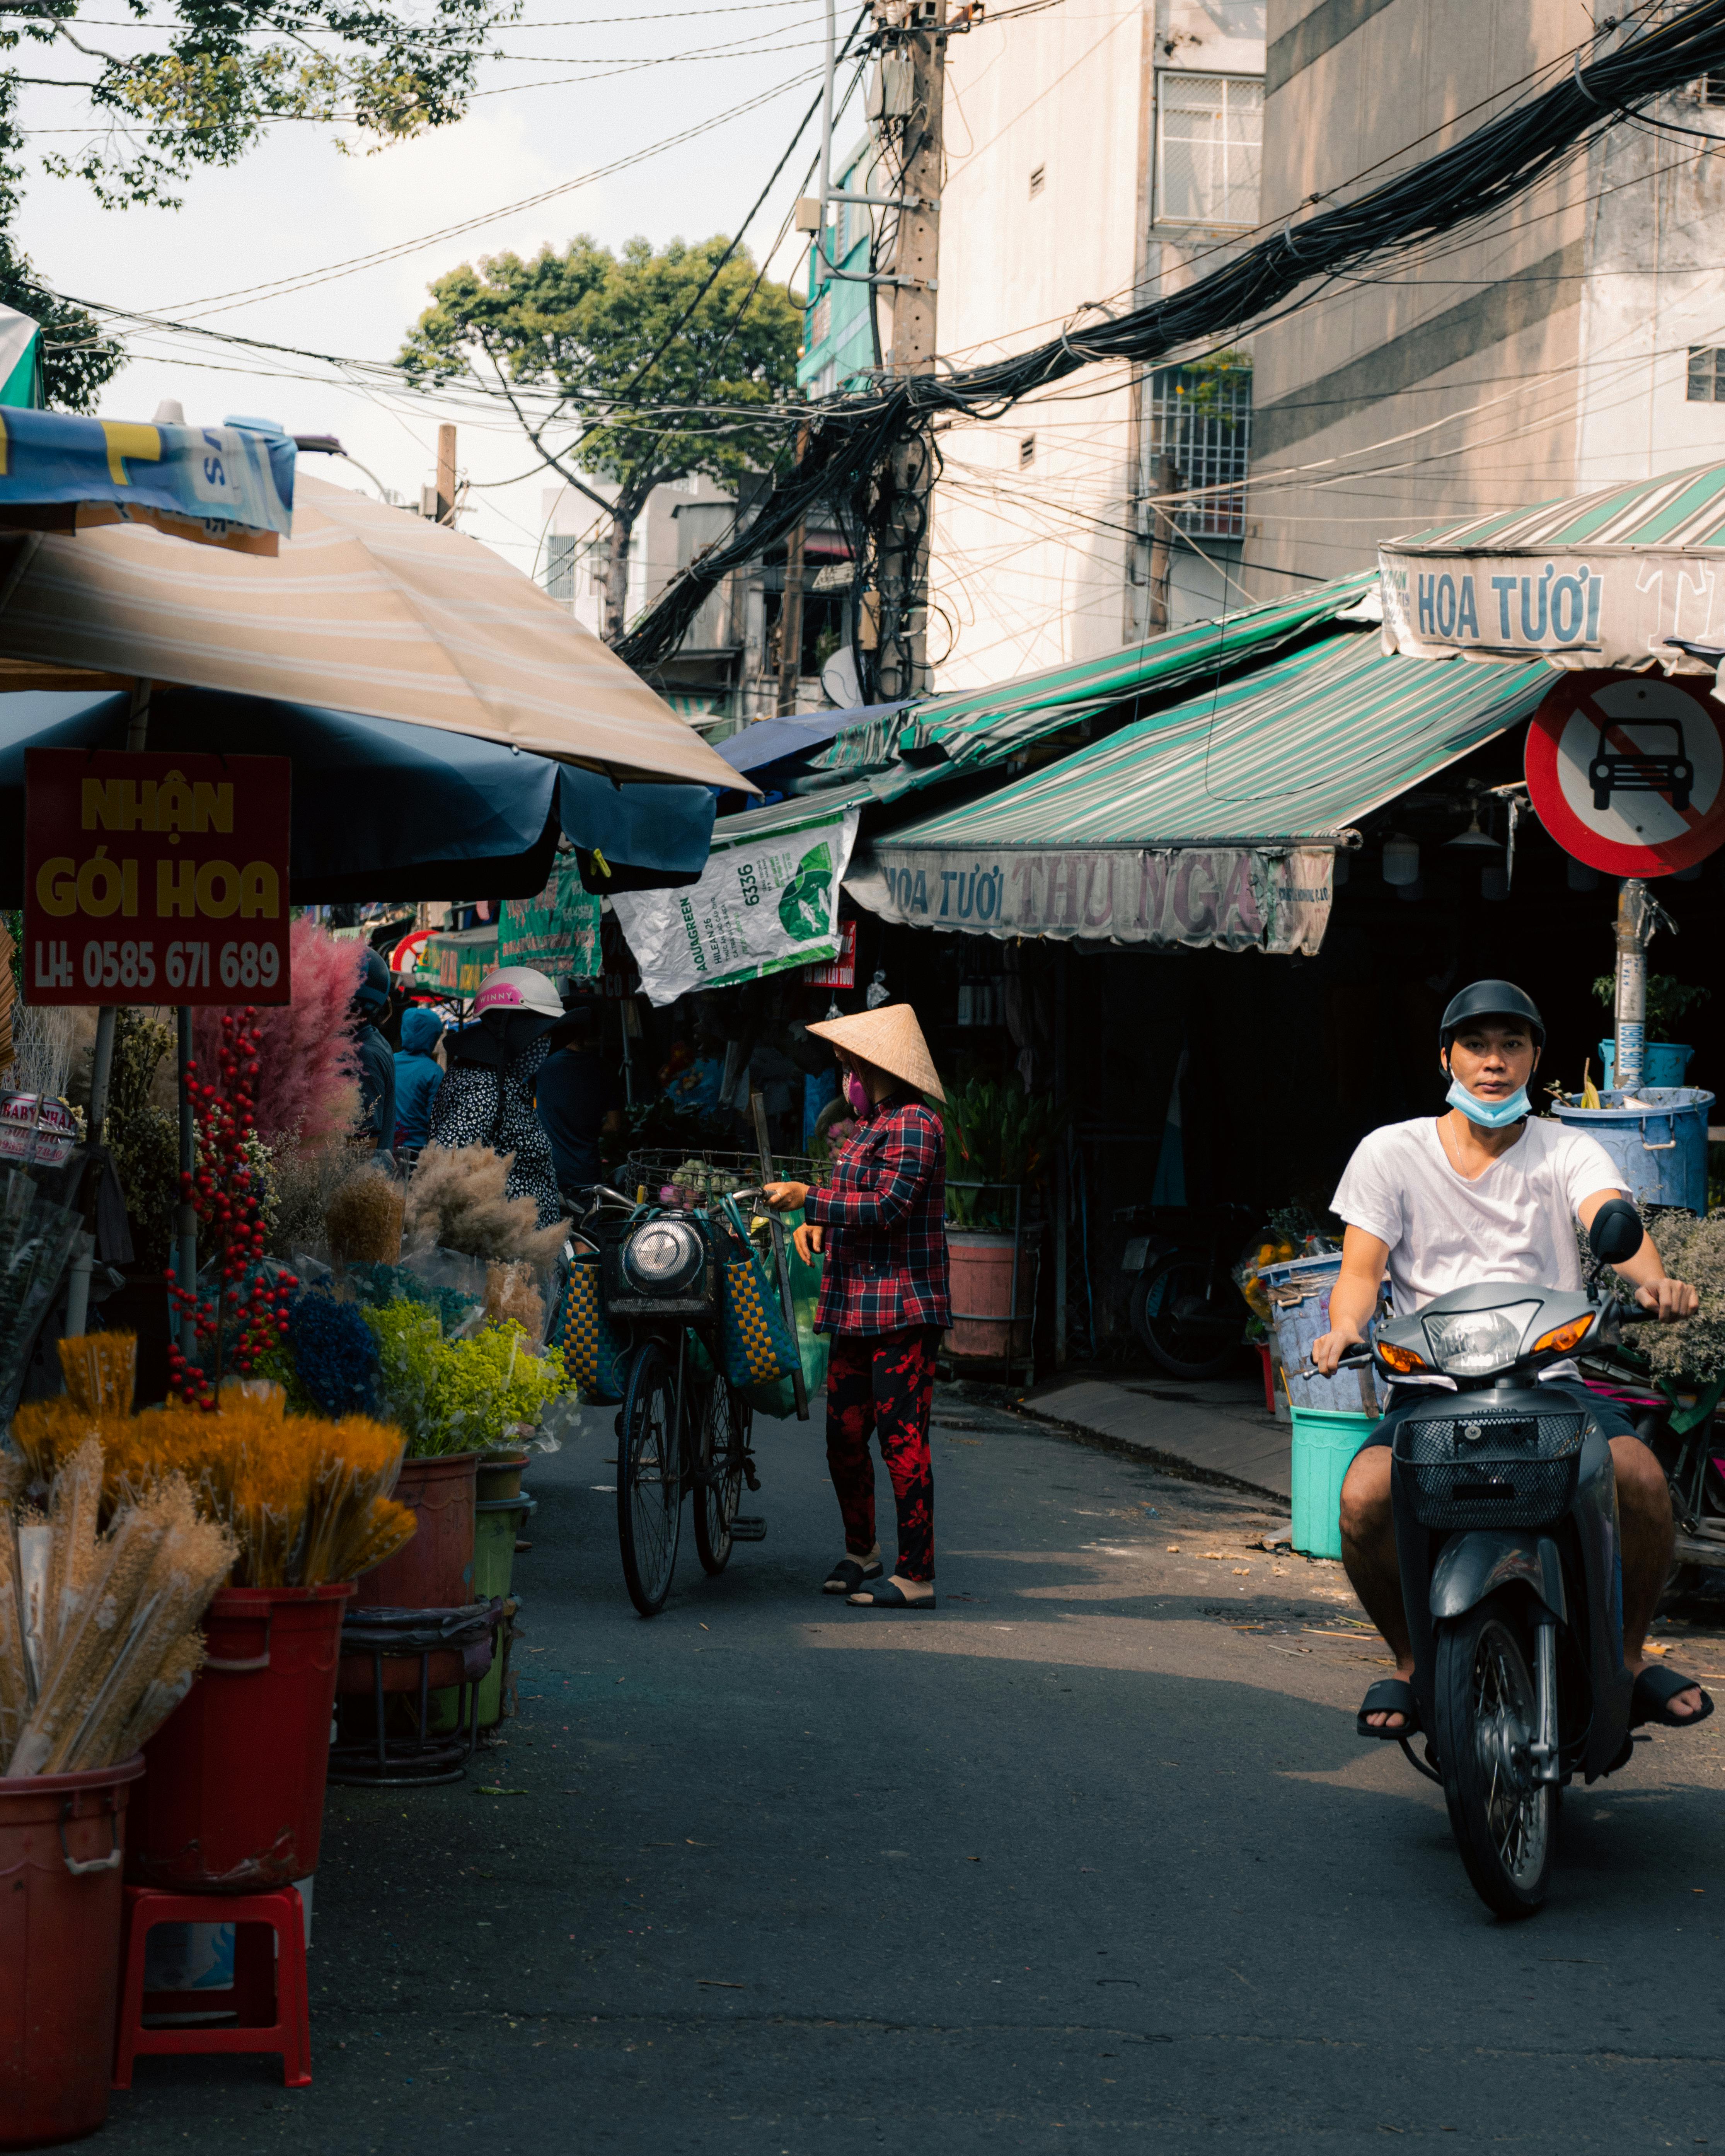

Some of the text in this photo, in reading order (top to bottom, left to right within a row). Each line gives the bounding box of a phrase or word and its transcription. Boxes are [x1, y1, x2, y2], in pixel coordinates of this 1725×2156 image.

[1418, 574, 1479, 639] HOA
[1492, 563, 1604, 642] TƯƠI
[82, 770, 234, 845] NHẬN
[36, 845, 280, 918] GÓI HOA
[738, 864, 760, 906] 6336
[884, 866, 929, 914] HOA
[940, 863, 1004, 920] TƯƠI
[680, 897, 707, 971] AQUAGREEN
[704, 918, 723, 965] HILEAN 26
[35, 941, 280, 988] LH: 0585 671 689
[480, 992, 513, 1003] WINNY
[2, 1103, 37, 1122] BABY
